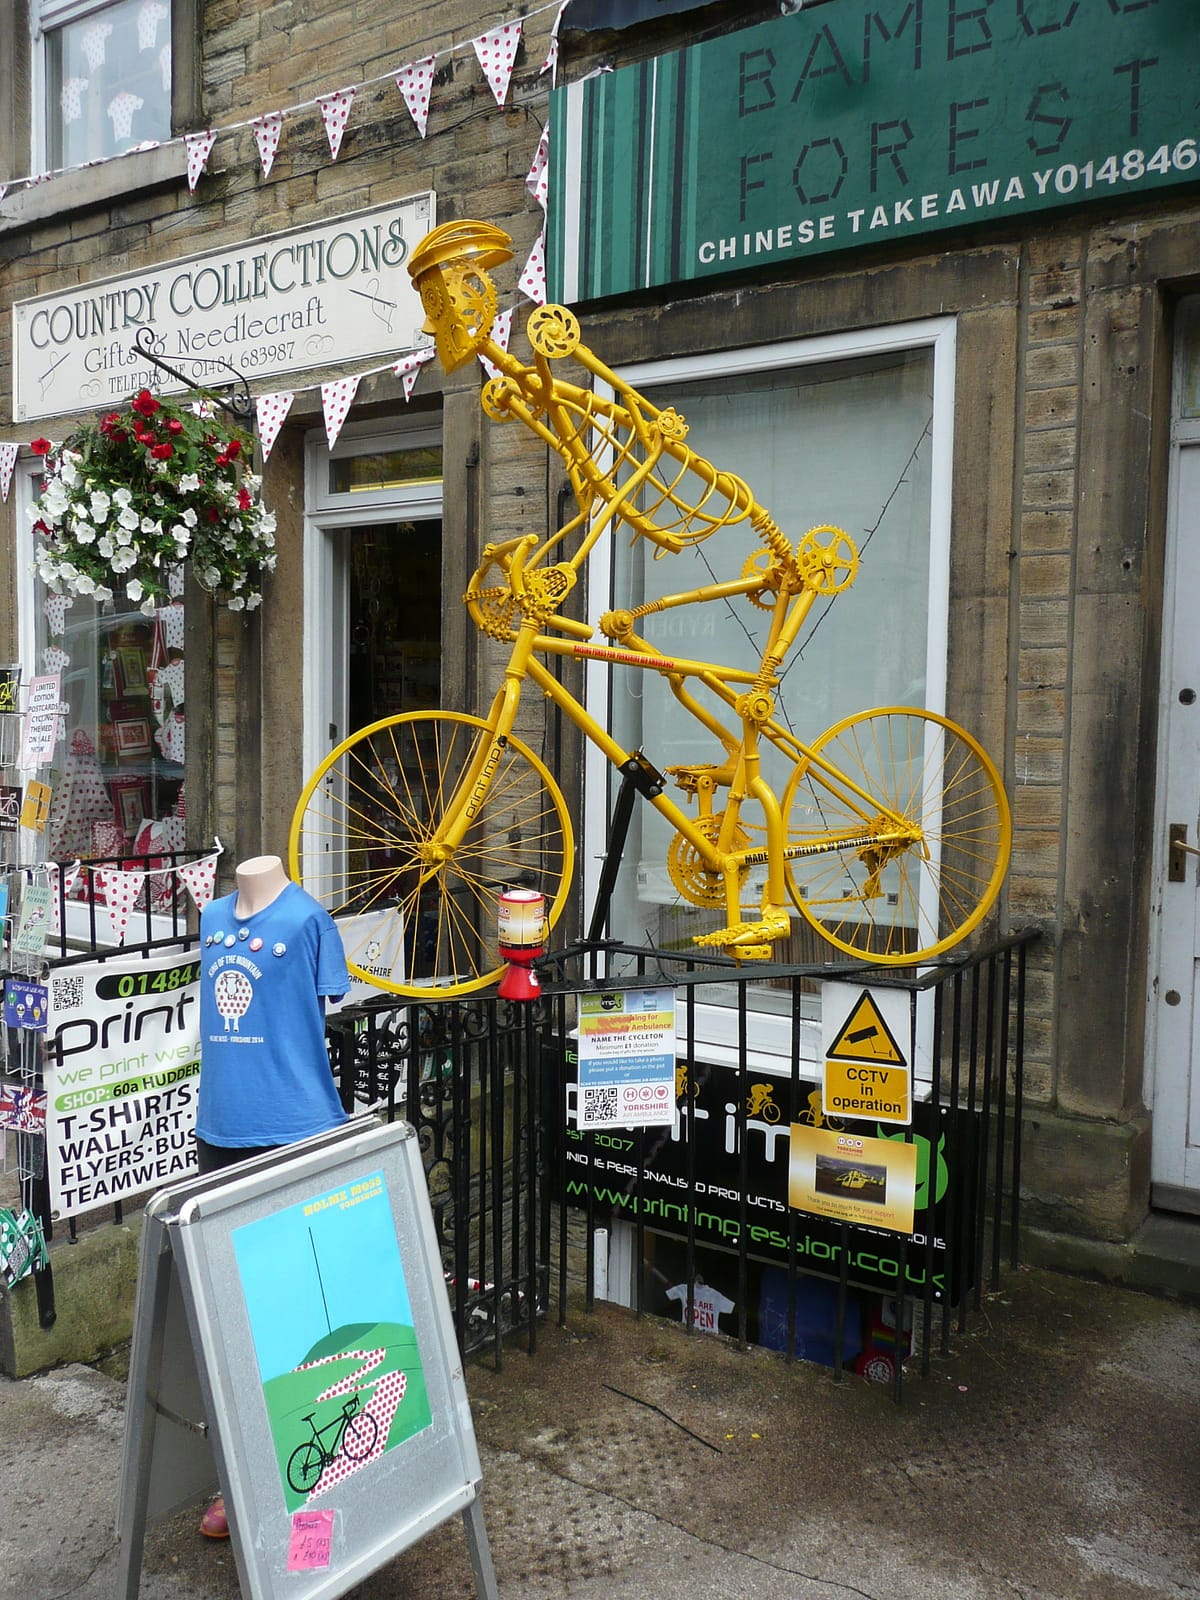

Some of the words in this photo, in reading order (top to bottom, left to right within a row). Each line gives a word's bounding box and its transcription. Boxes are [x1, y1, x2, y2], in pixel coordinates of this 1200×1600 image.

[739, 0, 1160, 118] BAMBO
[739, 56, 1160, 222] FOREST
[699, 214, 836, 264] CHINESE
[1054, 138, 1200, 194] 014846
[29, 281, 161, 349] COUNTRY
[169, 216, 409, 317] COLLECTIONS
[83, 344, 138, 374] Gifts
[177, 296, 328, 355] Needlecraft
[191, 354, 234, 379] 01484
[239, 341, 295, 369] 683987
[34, 693, 55, 702] EDITION
[36, 682, 56, 692] LIMITED
[28, 703, 58, 713] POSTCARDS
[31, 714, 53, 723] CYCLING
[30, 724, 53, 733] THEMED
[466, 780, 486, 819] print
[482, 748, 501, 779] imp
[745, 852, 769, 864] MADE
[118, 964, 193, 997] 01484
[55, 991, 195, 1066] print
[631, 1022, 672, 1031] Ambulance
[648, 1013, 658, 1021] for
[628, 1033, 664, 1041] CYCLETON
[57, 1064, 93, 1086] we
[100, 1054, 148, 1080] print
[155, 1043, 190, 1061] we
[846, 1067, 889, 1083] CCTV
[63, 1088, 110, 1111] SHOP:
[113, 1082, 139, 1098] 60a
[860, 1083, 873, 1096] in
[57, 1083, 192, 1141] T-SHIRTS
[623, 1102, 669, 1112] YORKSHIRE
[832, 1096, 902, 1114] operation
[58, 1129, 134, 1164] WALL
[139, 1110, 183, 1142] ART
[61, 1144, 145, 1186] FLYERS
[61, 1149, 199, 1208] TEAMWEAR
[708, 1184, 786, 1213] PROUCTS
[699, 1301, 714, 1311] ARE
